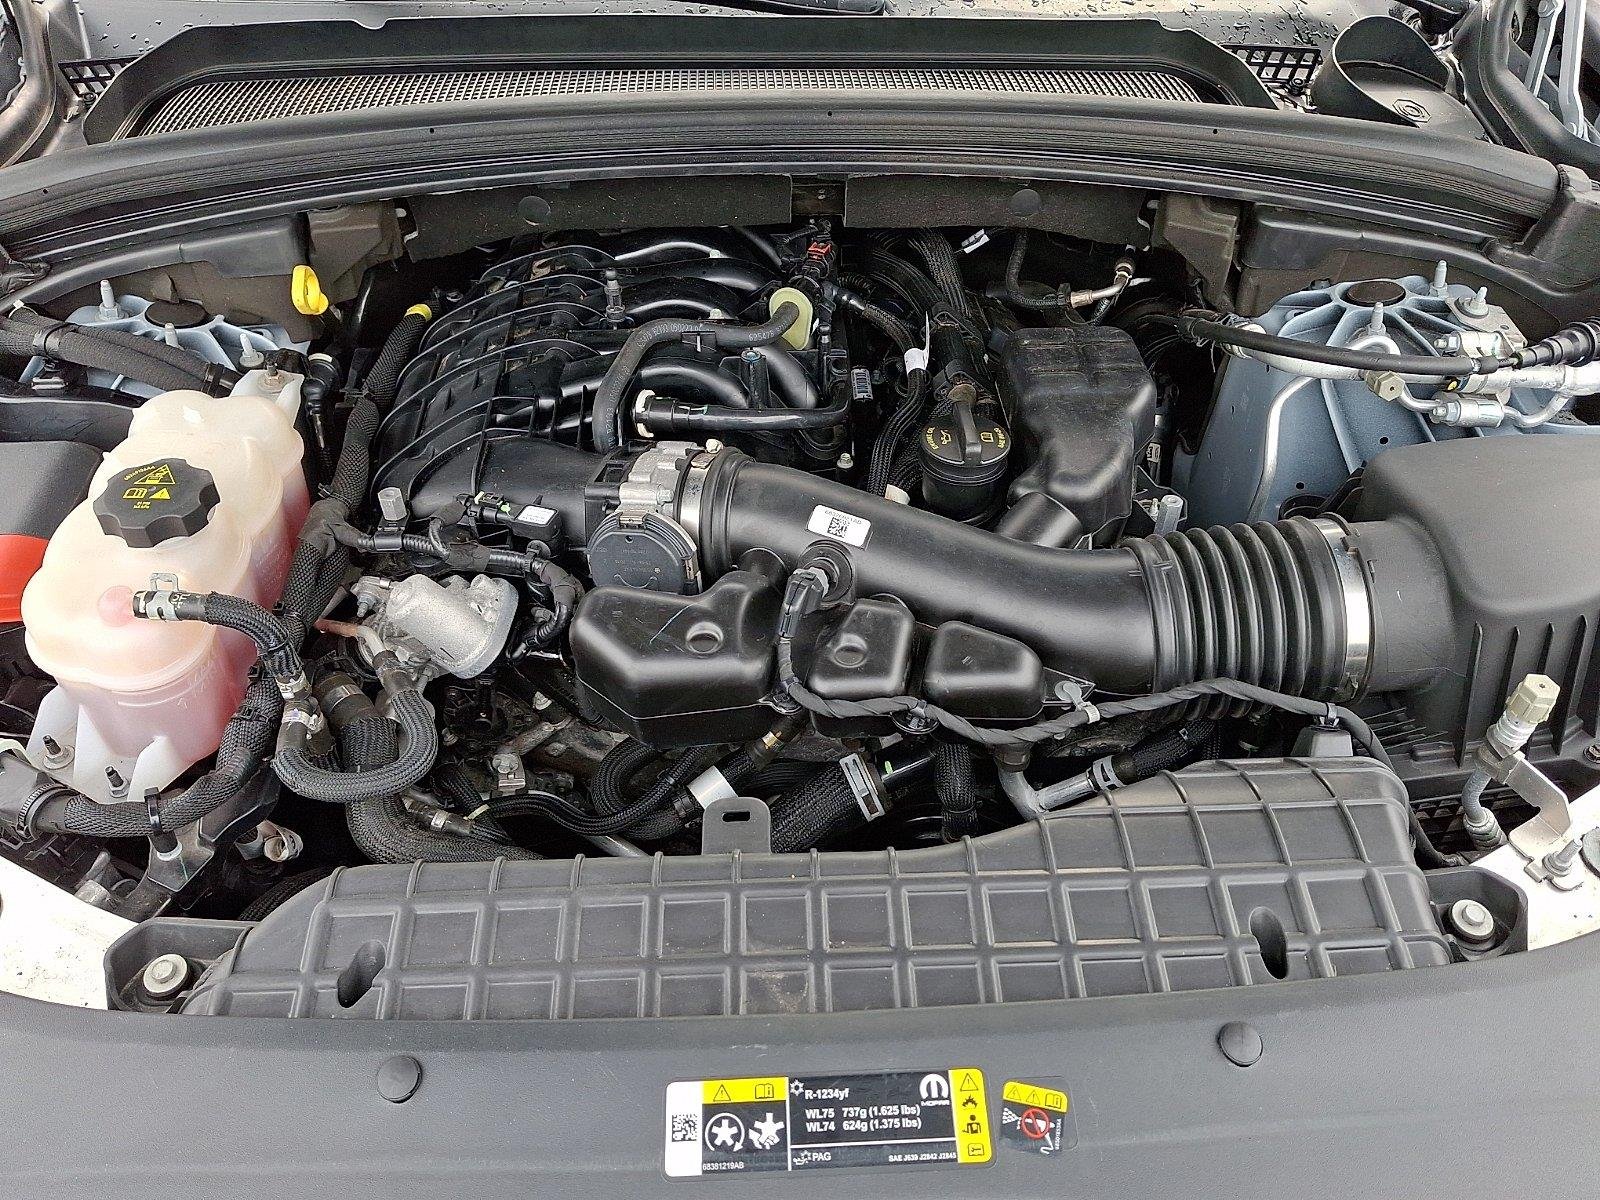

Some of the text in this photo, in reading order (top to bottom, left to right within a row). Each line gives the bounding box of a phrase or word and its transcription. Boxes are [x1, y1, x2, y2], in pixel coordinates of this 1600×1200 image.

[804, 1087, 849, 1100] R-1234yf
[920, 1099, 950, 1107] MOPAR
[805, 1104, 920, 1119] WL75 737g (1.625 lbs)
[806, 1117, 922, 1132] WL74 624g (1.375 lbs)
[812, 1152, 831, 1161] PAG
[702, 1161, 745, 1171] 68381219AB
